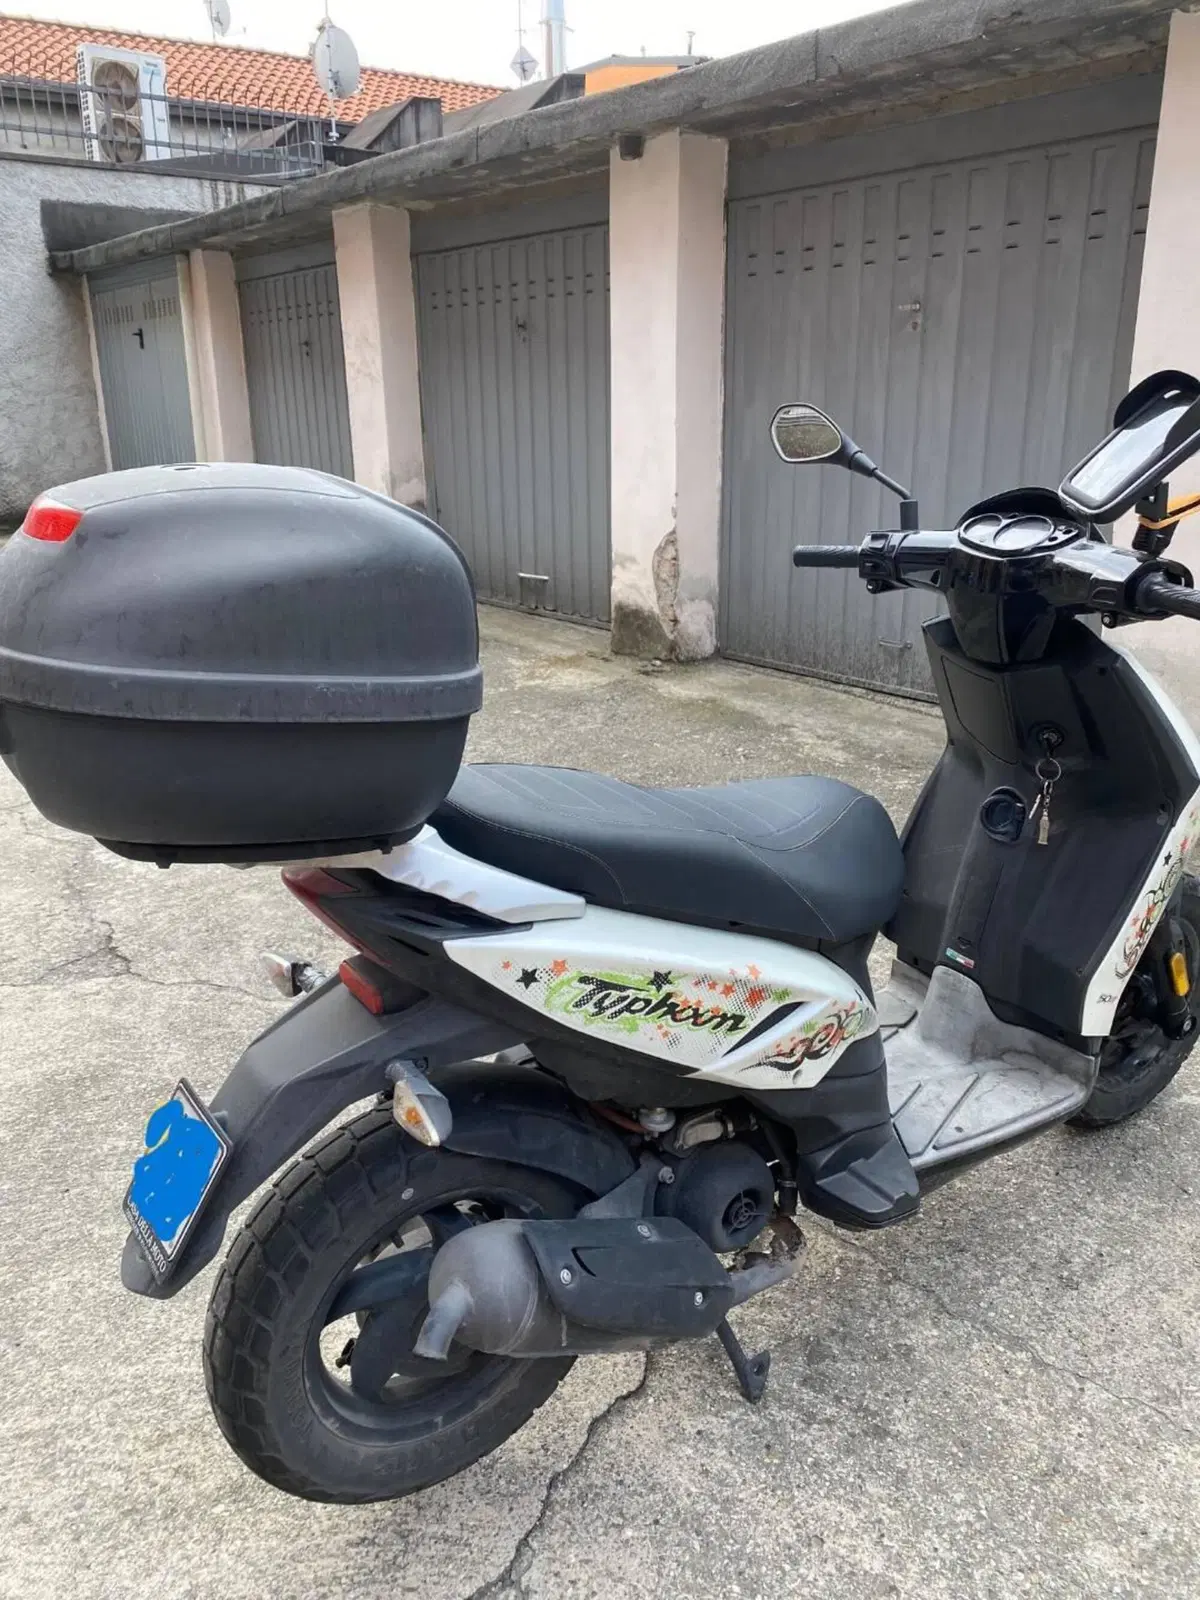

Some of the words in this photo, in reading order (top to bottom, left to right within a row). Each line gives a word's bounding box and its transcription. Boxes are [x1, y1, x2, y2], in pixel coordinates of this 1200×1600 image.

[572, 975, 750, 1032] Typhoon
[137, 1215, 155, 1248] DELLA
[150, 1241, 167, 1273] MOTO
